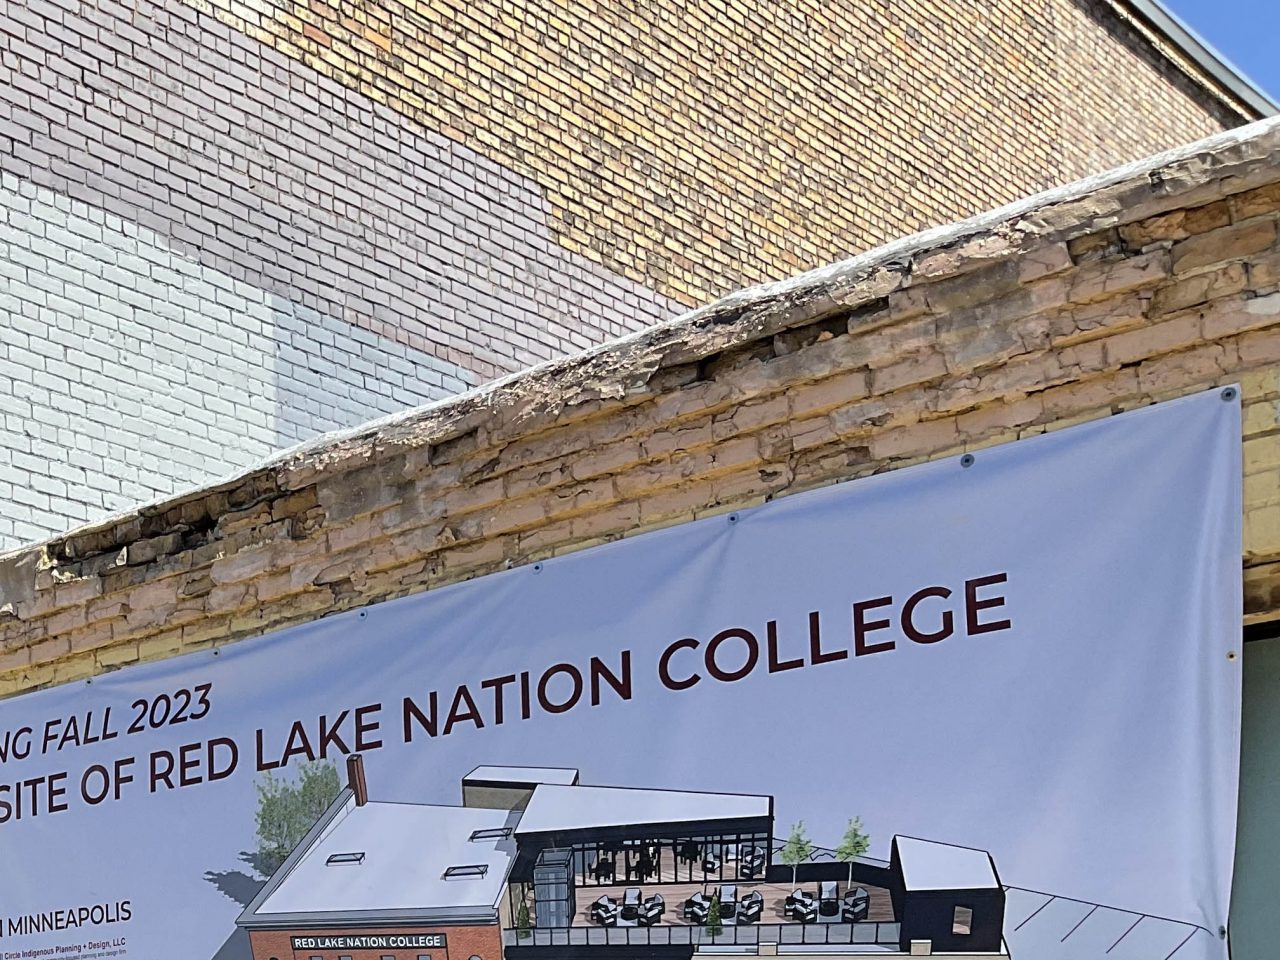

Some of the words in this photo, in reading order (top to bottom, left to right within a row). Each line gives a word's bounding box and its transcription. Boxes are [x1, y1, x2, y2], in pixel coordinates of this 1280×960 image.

[80, 756, 136, 805] OF
[150, 736, 239, 793] RED
[254, 702, 385, 773] LAKE
[403, 650, 633, 744] NATION
[657, 572, 1011, 692] COLLEGE
[41, 706, 119, 754] FALL
[128, 682, 215, 735] 2023
[8, 900, 132, 937] MINNEAPOLIS
[4, 950, 21, 960] Circle
[22, 947, 54, 958] Indigenous
[55, 943, 81, 953] Planning
[88, 940, 111, 951] Design,
[112, 937, 126, 946] LLC
[295, 938, 315, 948] RED
[318, 937, 344, 948] LAKE
[346, 936, 387, 947] NATION
[389, 935, 441, 947] COLLEGE
